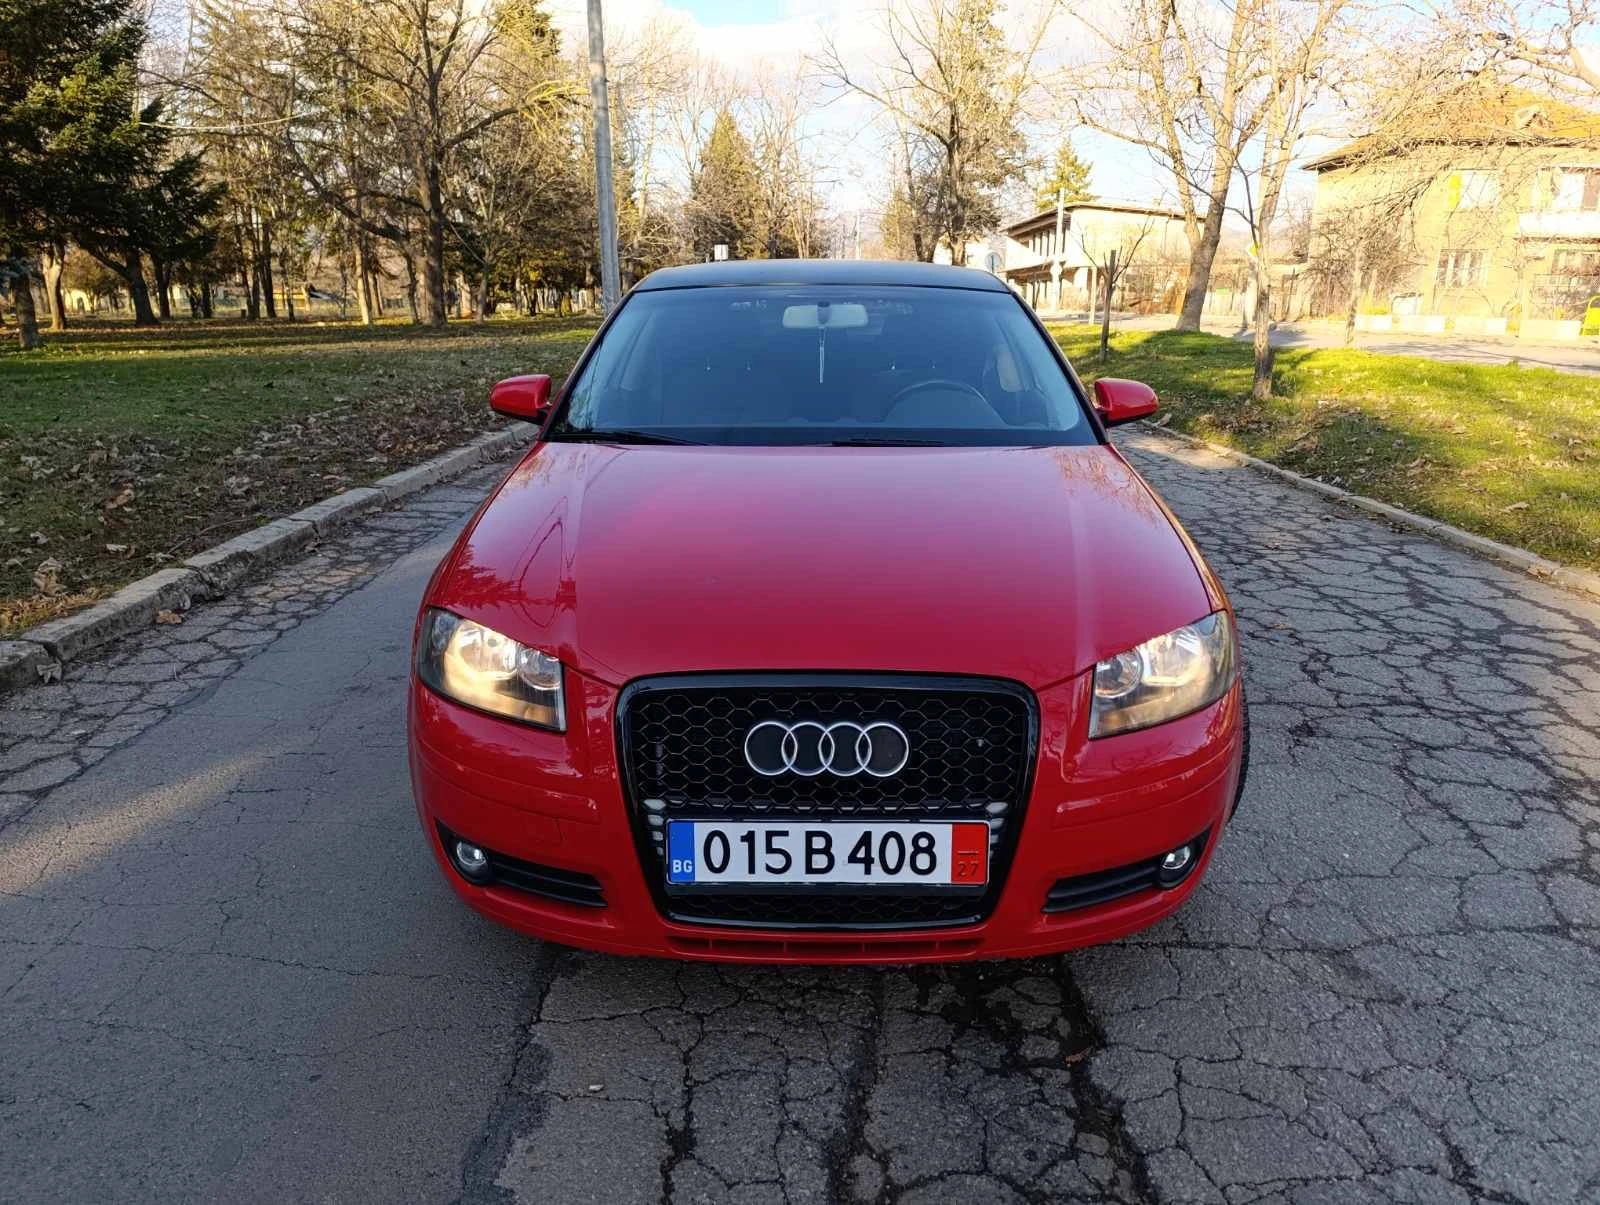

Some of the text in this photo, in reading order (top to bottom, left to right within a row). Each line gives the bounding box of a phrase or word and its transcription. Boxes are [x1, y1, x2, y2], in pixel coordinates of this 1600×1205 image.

[847, 830, 938, 876] 408
[672, 860, 693, 873] BG
[957, 863, 979, 877] 27
